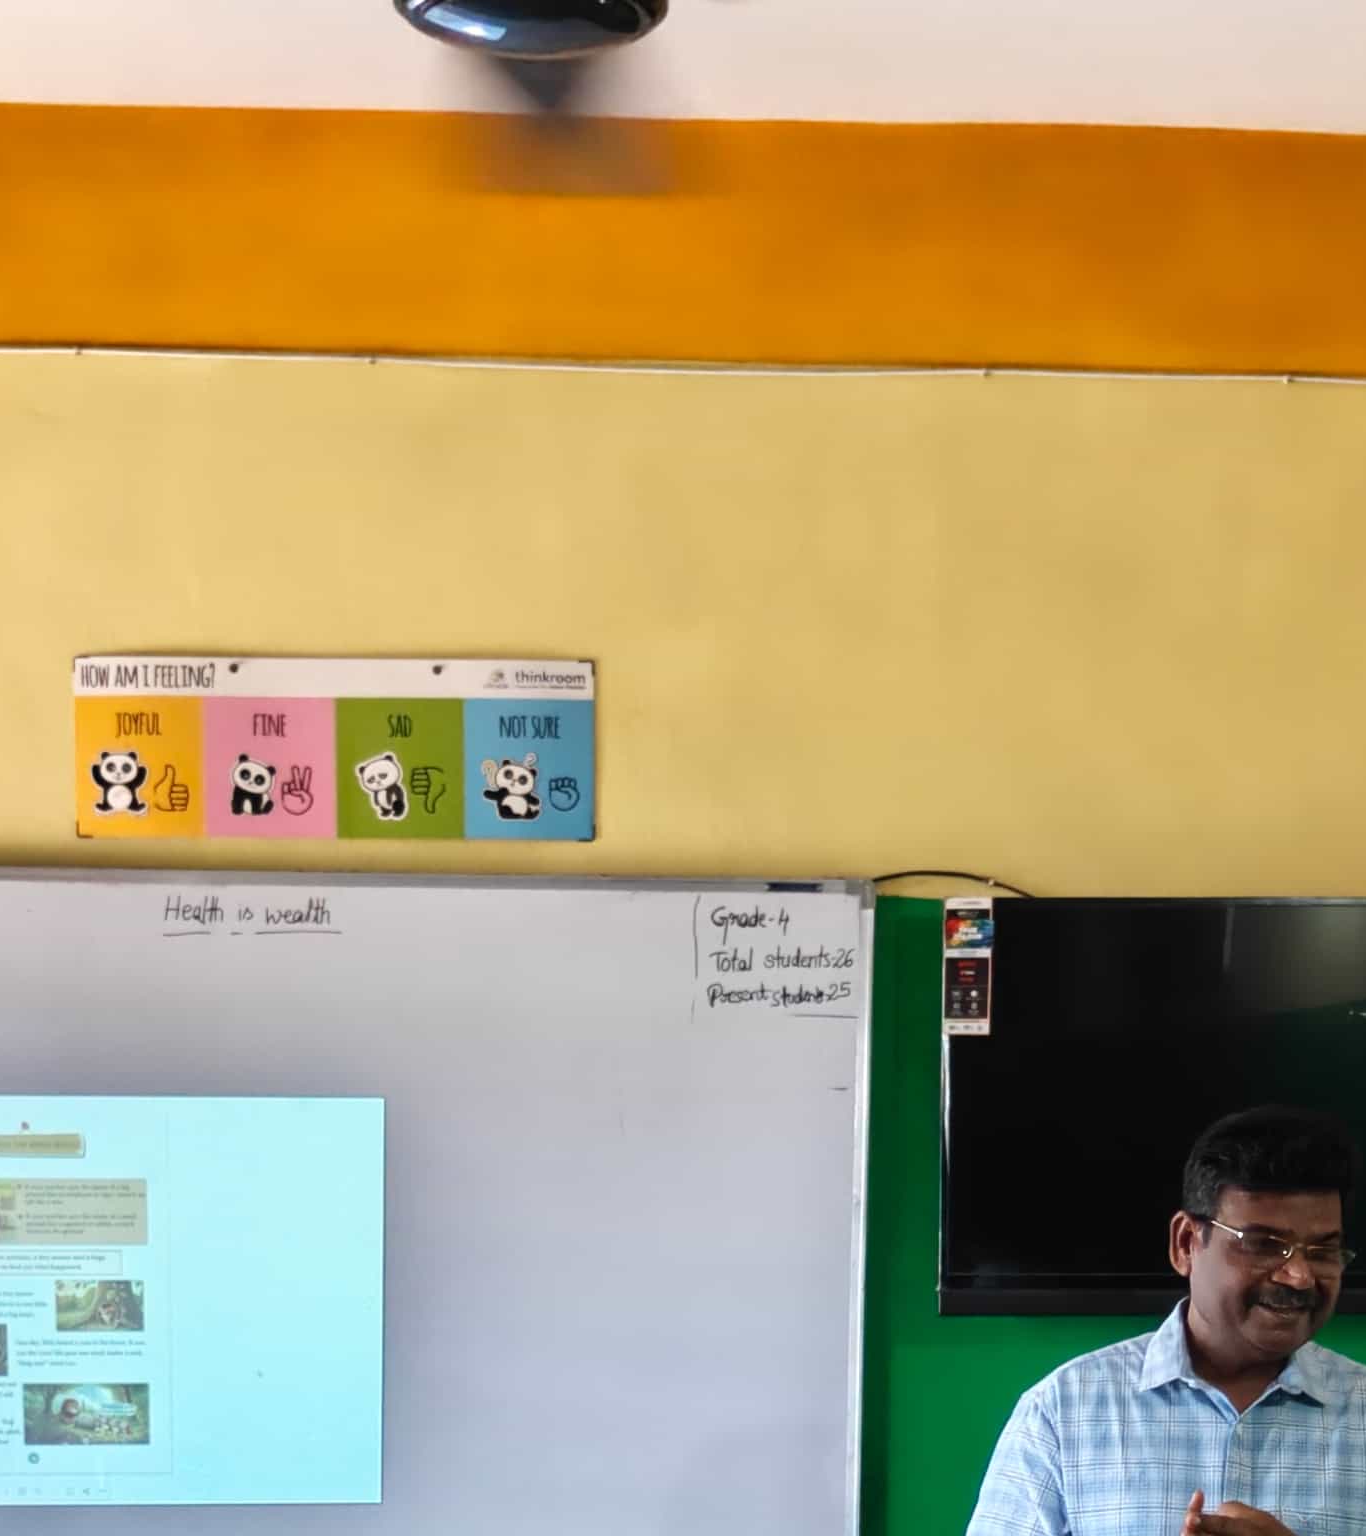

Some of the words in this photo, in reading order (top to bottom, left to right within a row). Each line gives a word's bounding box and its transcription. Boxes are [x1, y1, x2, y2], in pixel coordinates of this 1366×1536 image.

[80, 664, 110, 689] HOW
[115, 664, 139, 689] AM
[143, 665, 150, 688] I
[154, 662, 216, 689] FEELING?
[515, 671, 587, 685] thinkroom
[115, 712, 162, 738] JOYFUL
[253, 713, 287, 737] FINE
[387, 714, 412, 738] SAD
[499, 715, 527, 739] NOT
[531, 715, 561, 740] SURE
[164, 896, 224, 925] Health
[238, 907, 254, 921] is
[266, 896, 331, 925] wealth
[709, 947, 753, 972] Total
